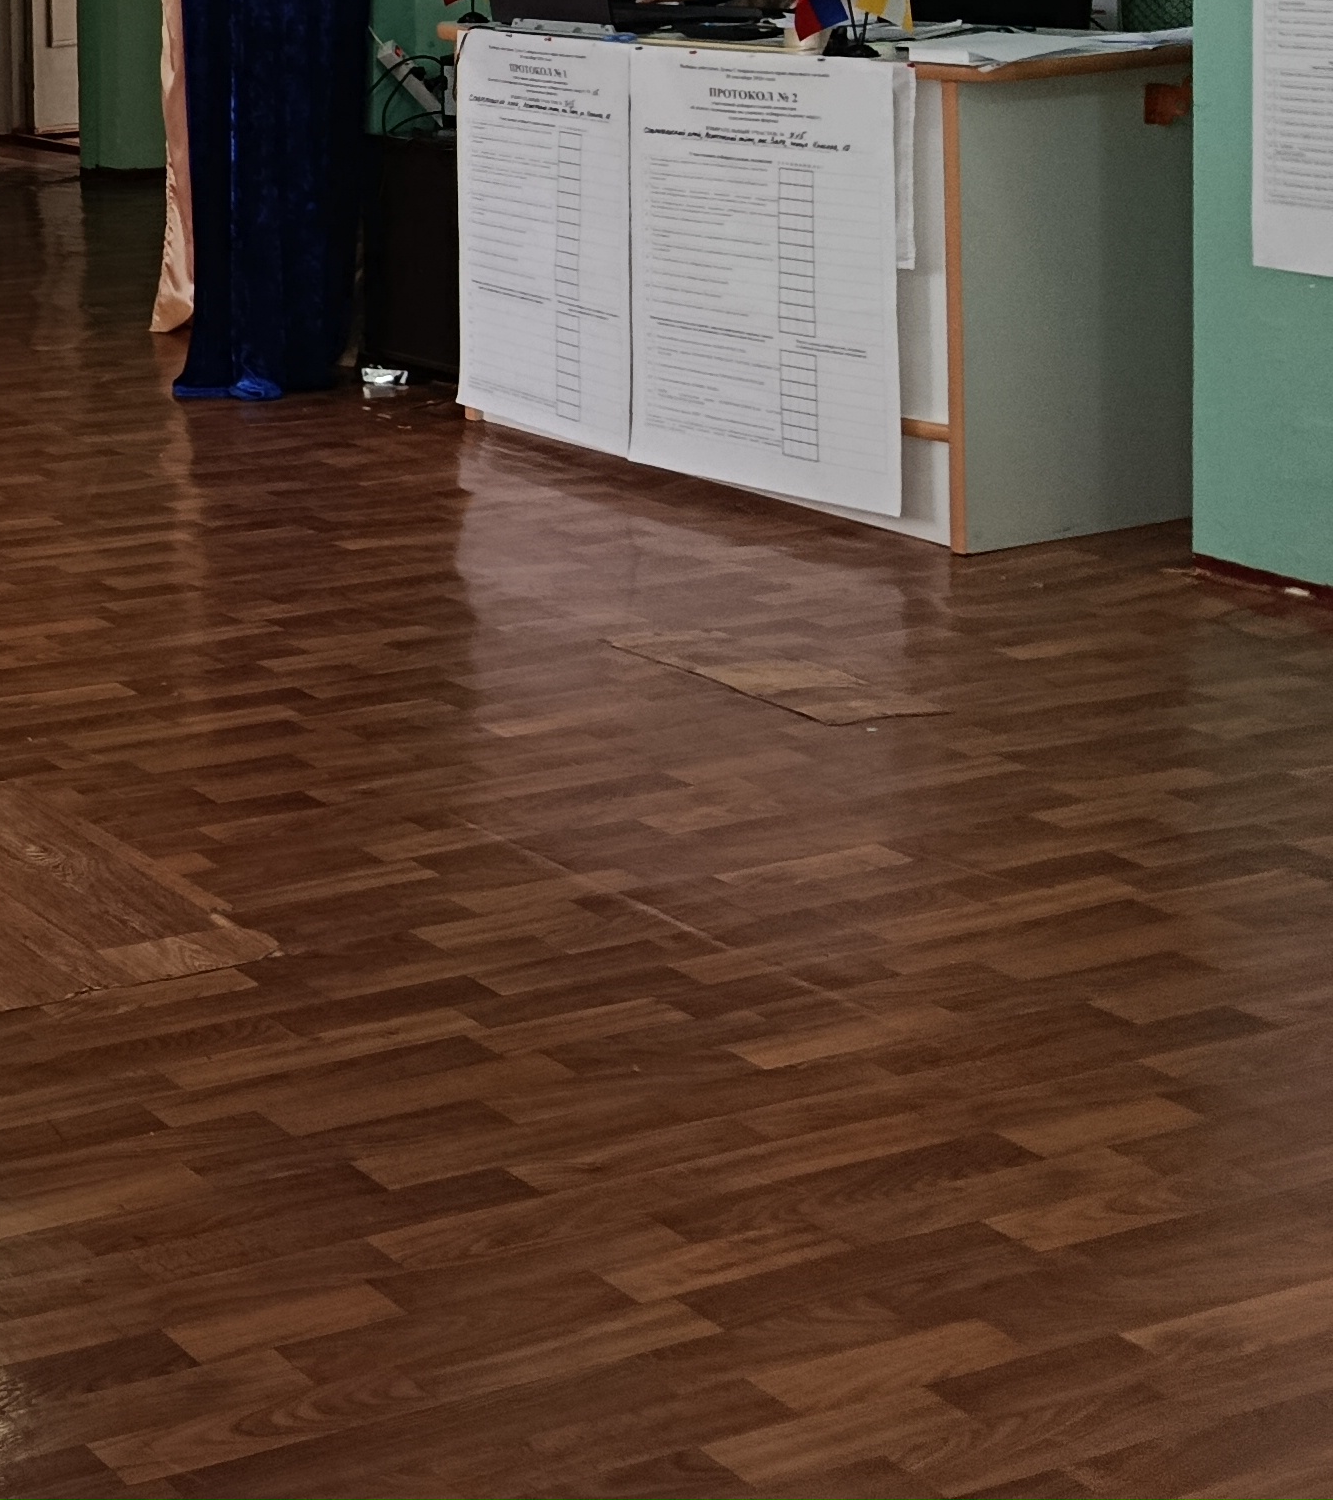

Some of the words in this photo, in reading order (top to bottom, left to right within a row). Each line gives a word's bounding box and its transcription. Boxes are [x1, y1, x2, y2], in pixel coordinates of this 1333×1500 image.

[709, 87, 774, 101] ПРОТОКОЛ
[777, 92, 789, 103] №
[791, 93, 798, 103] 2
